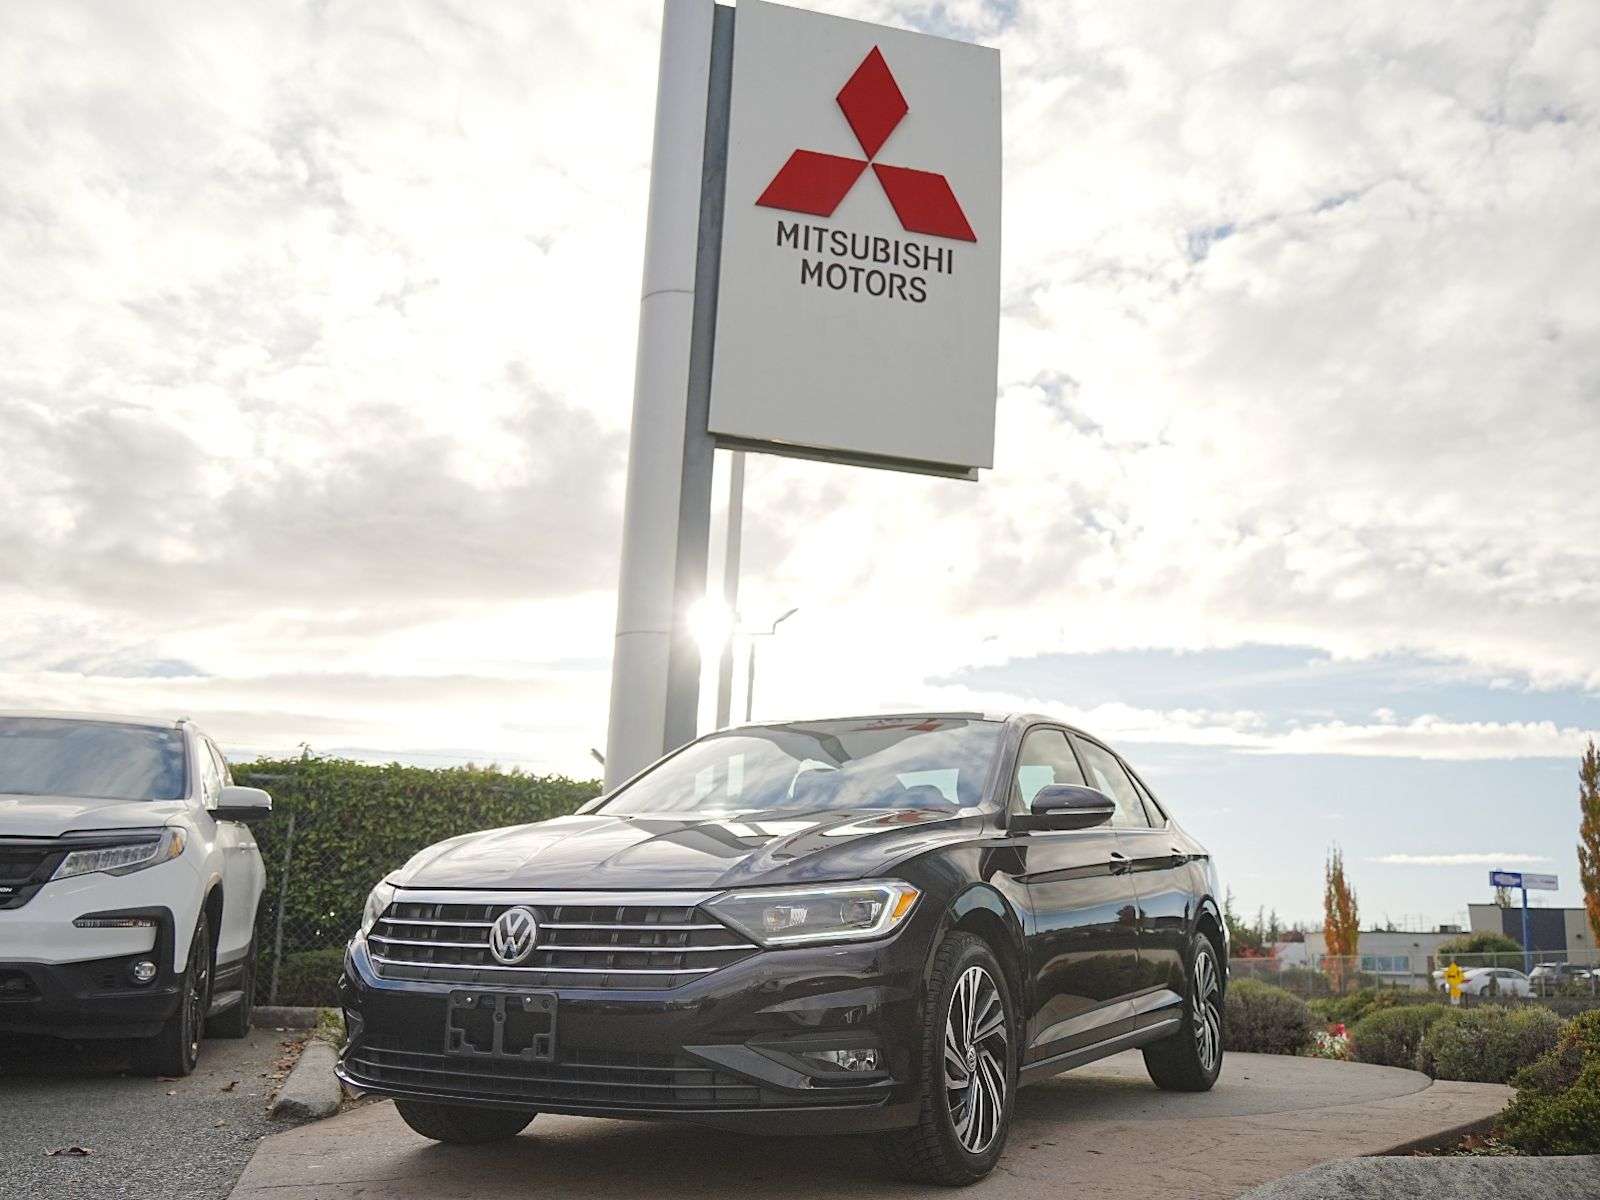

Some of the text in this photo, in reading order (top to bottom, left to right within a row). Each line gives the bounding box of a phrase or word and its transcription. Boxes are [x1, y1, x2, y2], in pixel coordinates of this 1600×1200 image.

[776, 221, 953, 274] MITSUBISHI
[801, 259, 927, 303] MOTORS
[490, 909, 535, 963] VW
